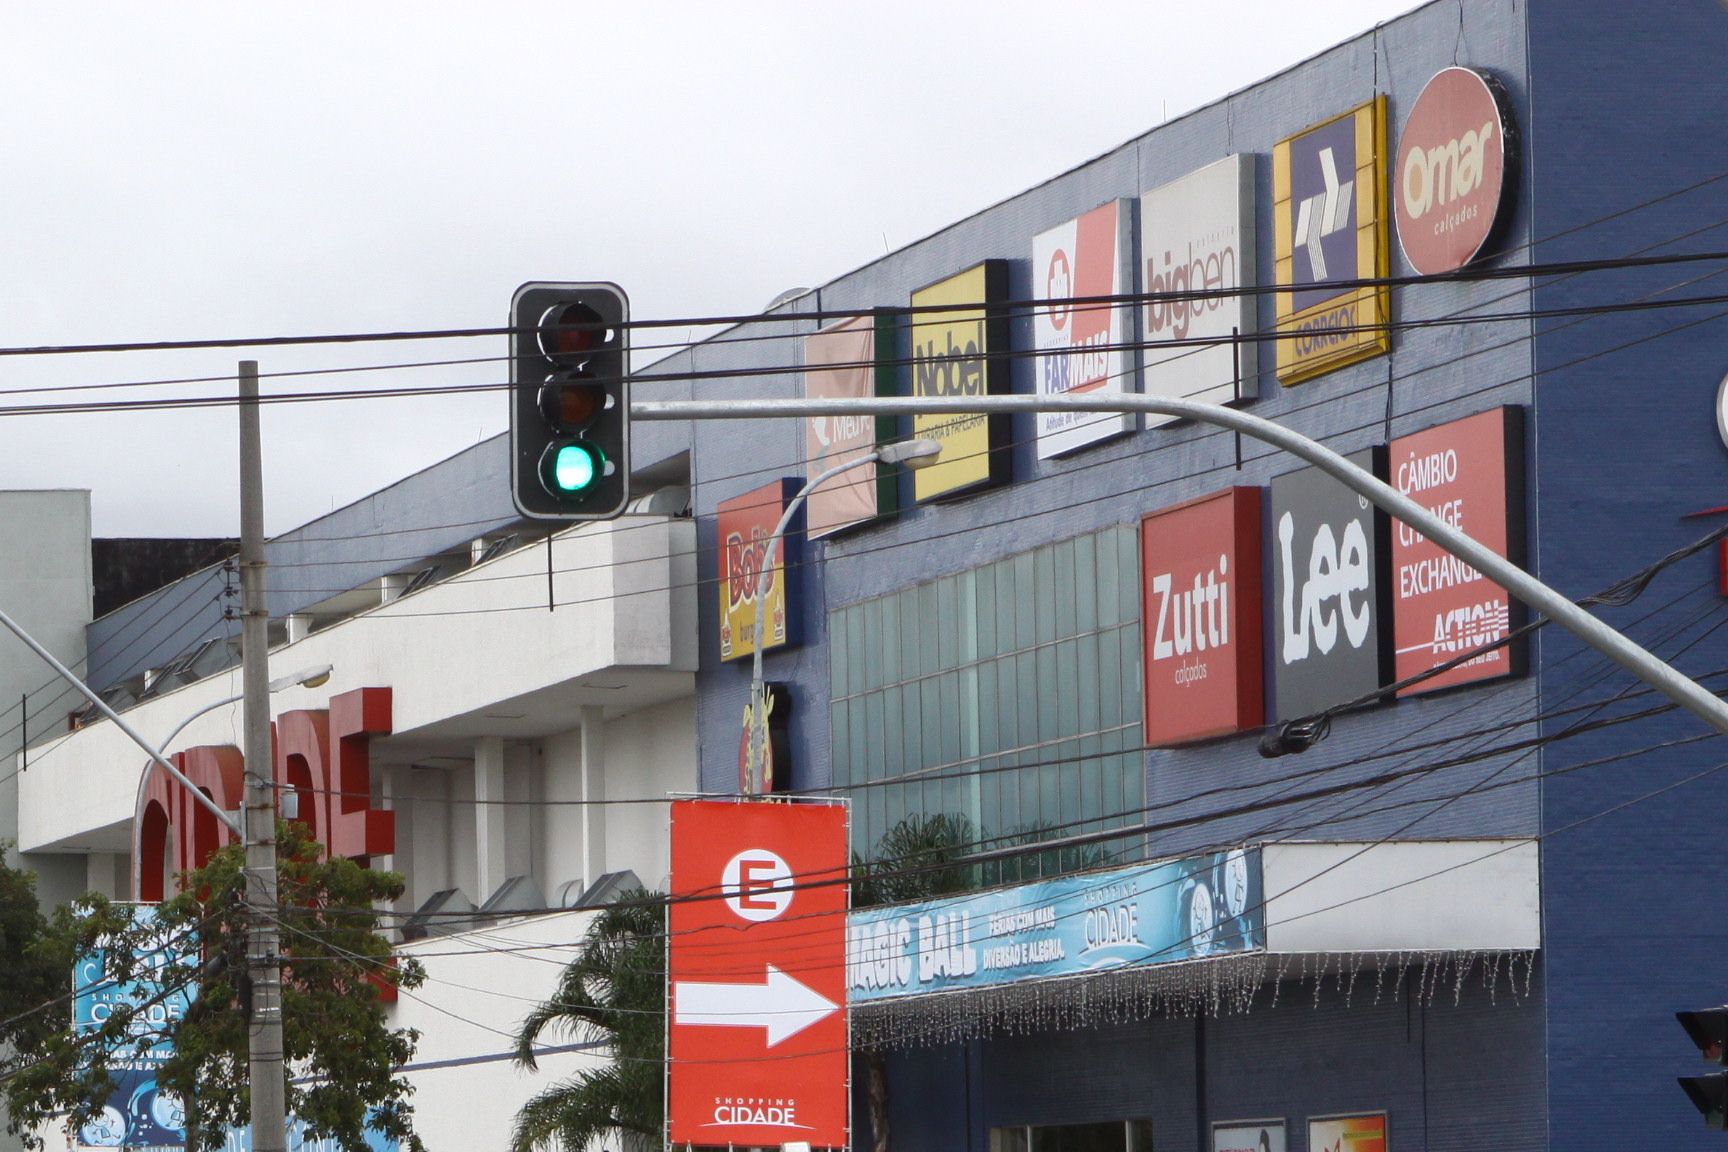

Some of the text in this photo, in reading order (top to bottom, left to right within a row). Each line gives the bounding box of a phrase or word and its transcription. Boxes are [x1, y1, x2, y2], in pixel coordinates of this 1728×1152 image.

[1403, 121, 1493, 220] omar
[1434, 204, 1478, 237] calçados
[1294, 303, 1358, 358] CORREIOS
[917, 320, 984, 420] Nobel
[1398, 449, 1458, 497] CÂMBIO
[1399, 499, 1463, 547] CHNGE
[1152, 553, 1230, 661] Zutti
[1278, 511, 1370, 665] Lee
[1433, 598, 1501, 655] ACTION
[1175, 661, 1208, 686] calçados
[918, 910, 977, 985] BALL
[1084, 902, 1139, 949] CIDADE
[983, 940, 1021, 972] DIVERSÃO
[713, 1105, 796, 1126] CIDADE
[714, 1096, 796, 1106] SHOPPING
